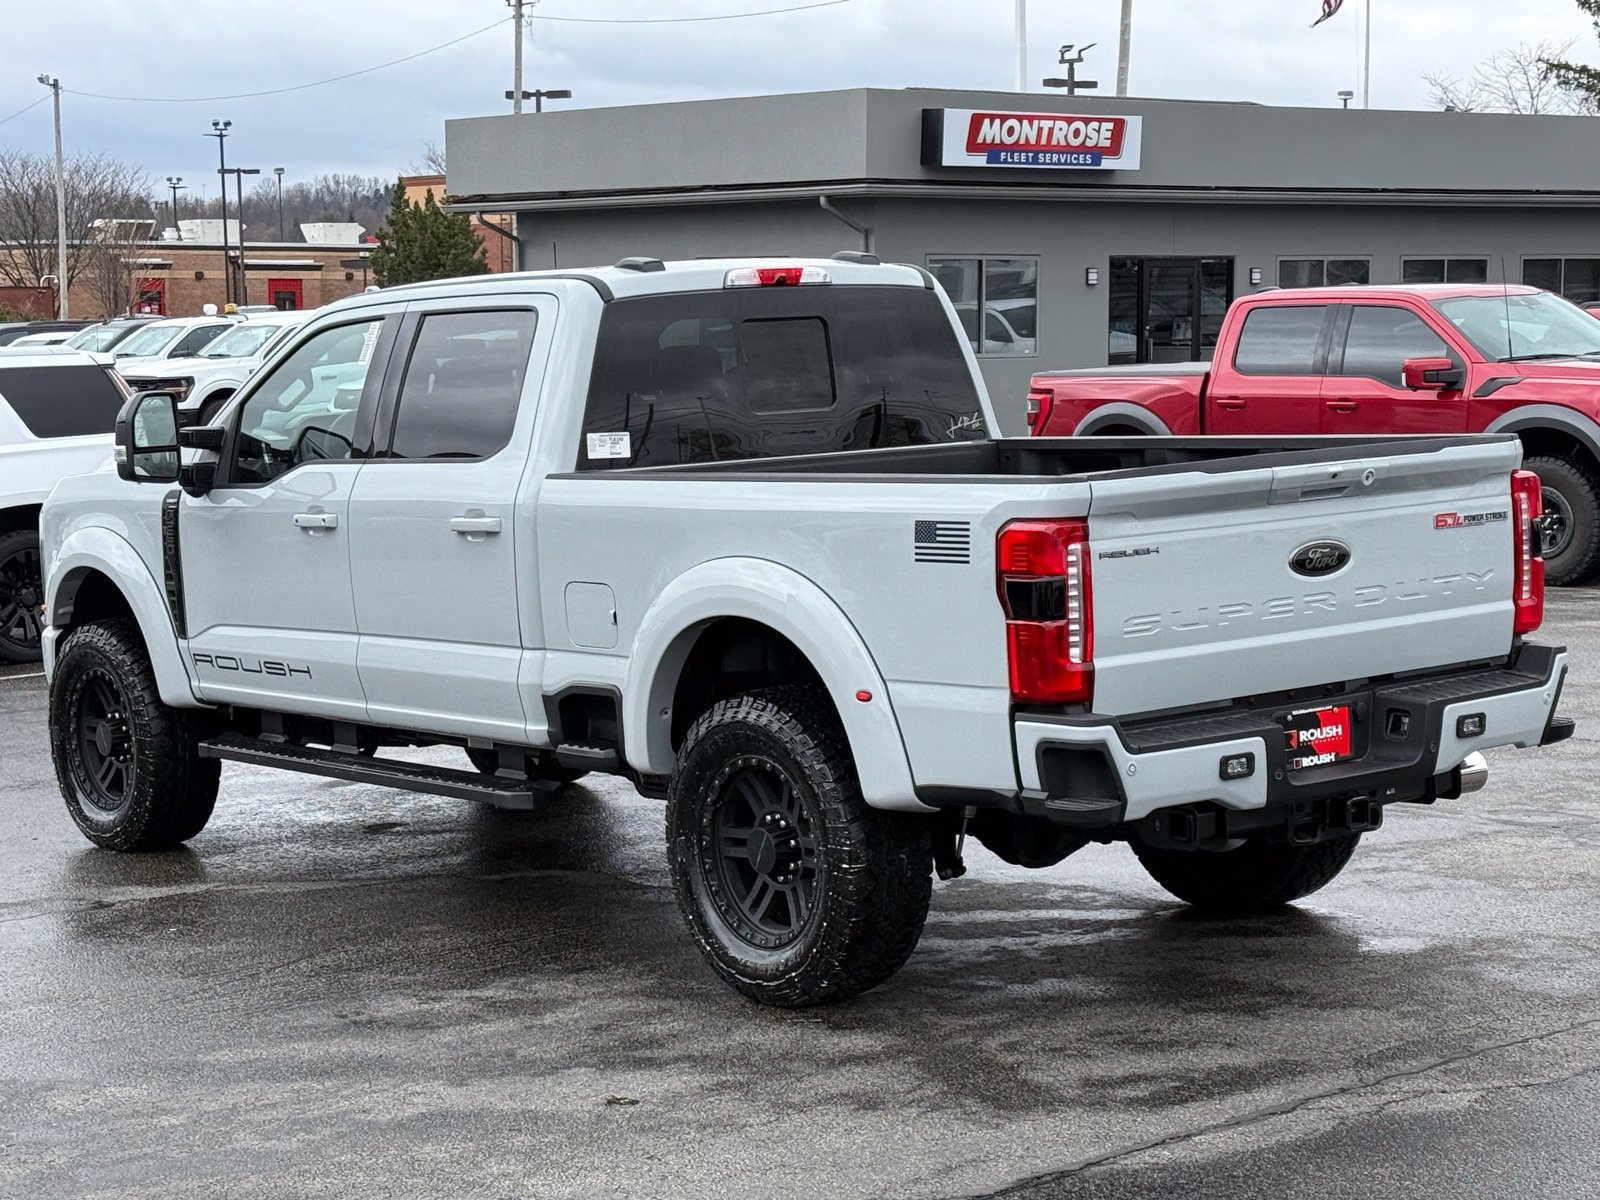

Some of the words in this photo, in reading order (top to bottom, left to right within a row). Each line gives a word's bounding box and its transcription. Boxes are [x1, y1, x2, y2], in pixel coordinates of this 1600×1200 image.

[976, 118, 1114, 147] MONTROSE
[1000, 152, 1034, 163] FLEET
[1038, 153, 1092, 164] SERVICES
[1463, 513, 1484, 522] POWER
[1485, 511, 1508, 520] STROKE
[1099, 546, 1160, 560] ROUSH
[1305, 548, 1340, 569] Ford
[1123, 591, 1337, 638] SUPER
[1354, 569, 1495, 608] DUTY
[193, 653, 312, 679] ROUSH
[1299, 724, 1343, 742] ROUSH
[1302, 752, 1337, 767] ROUSH
